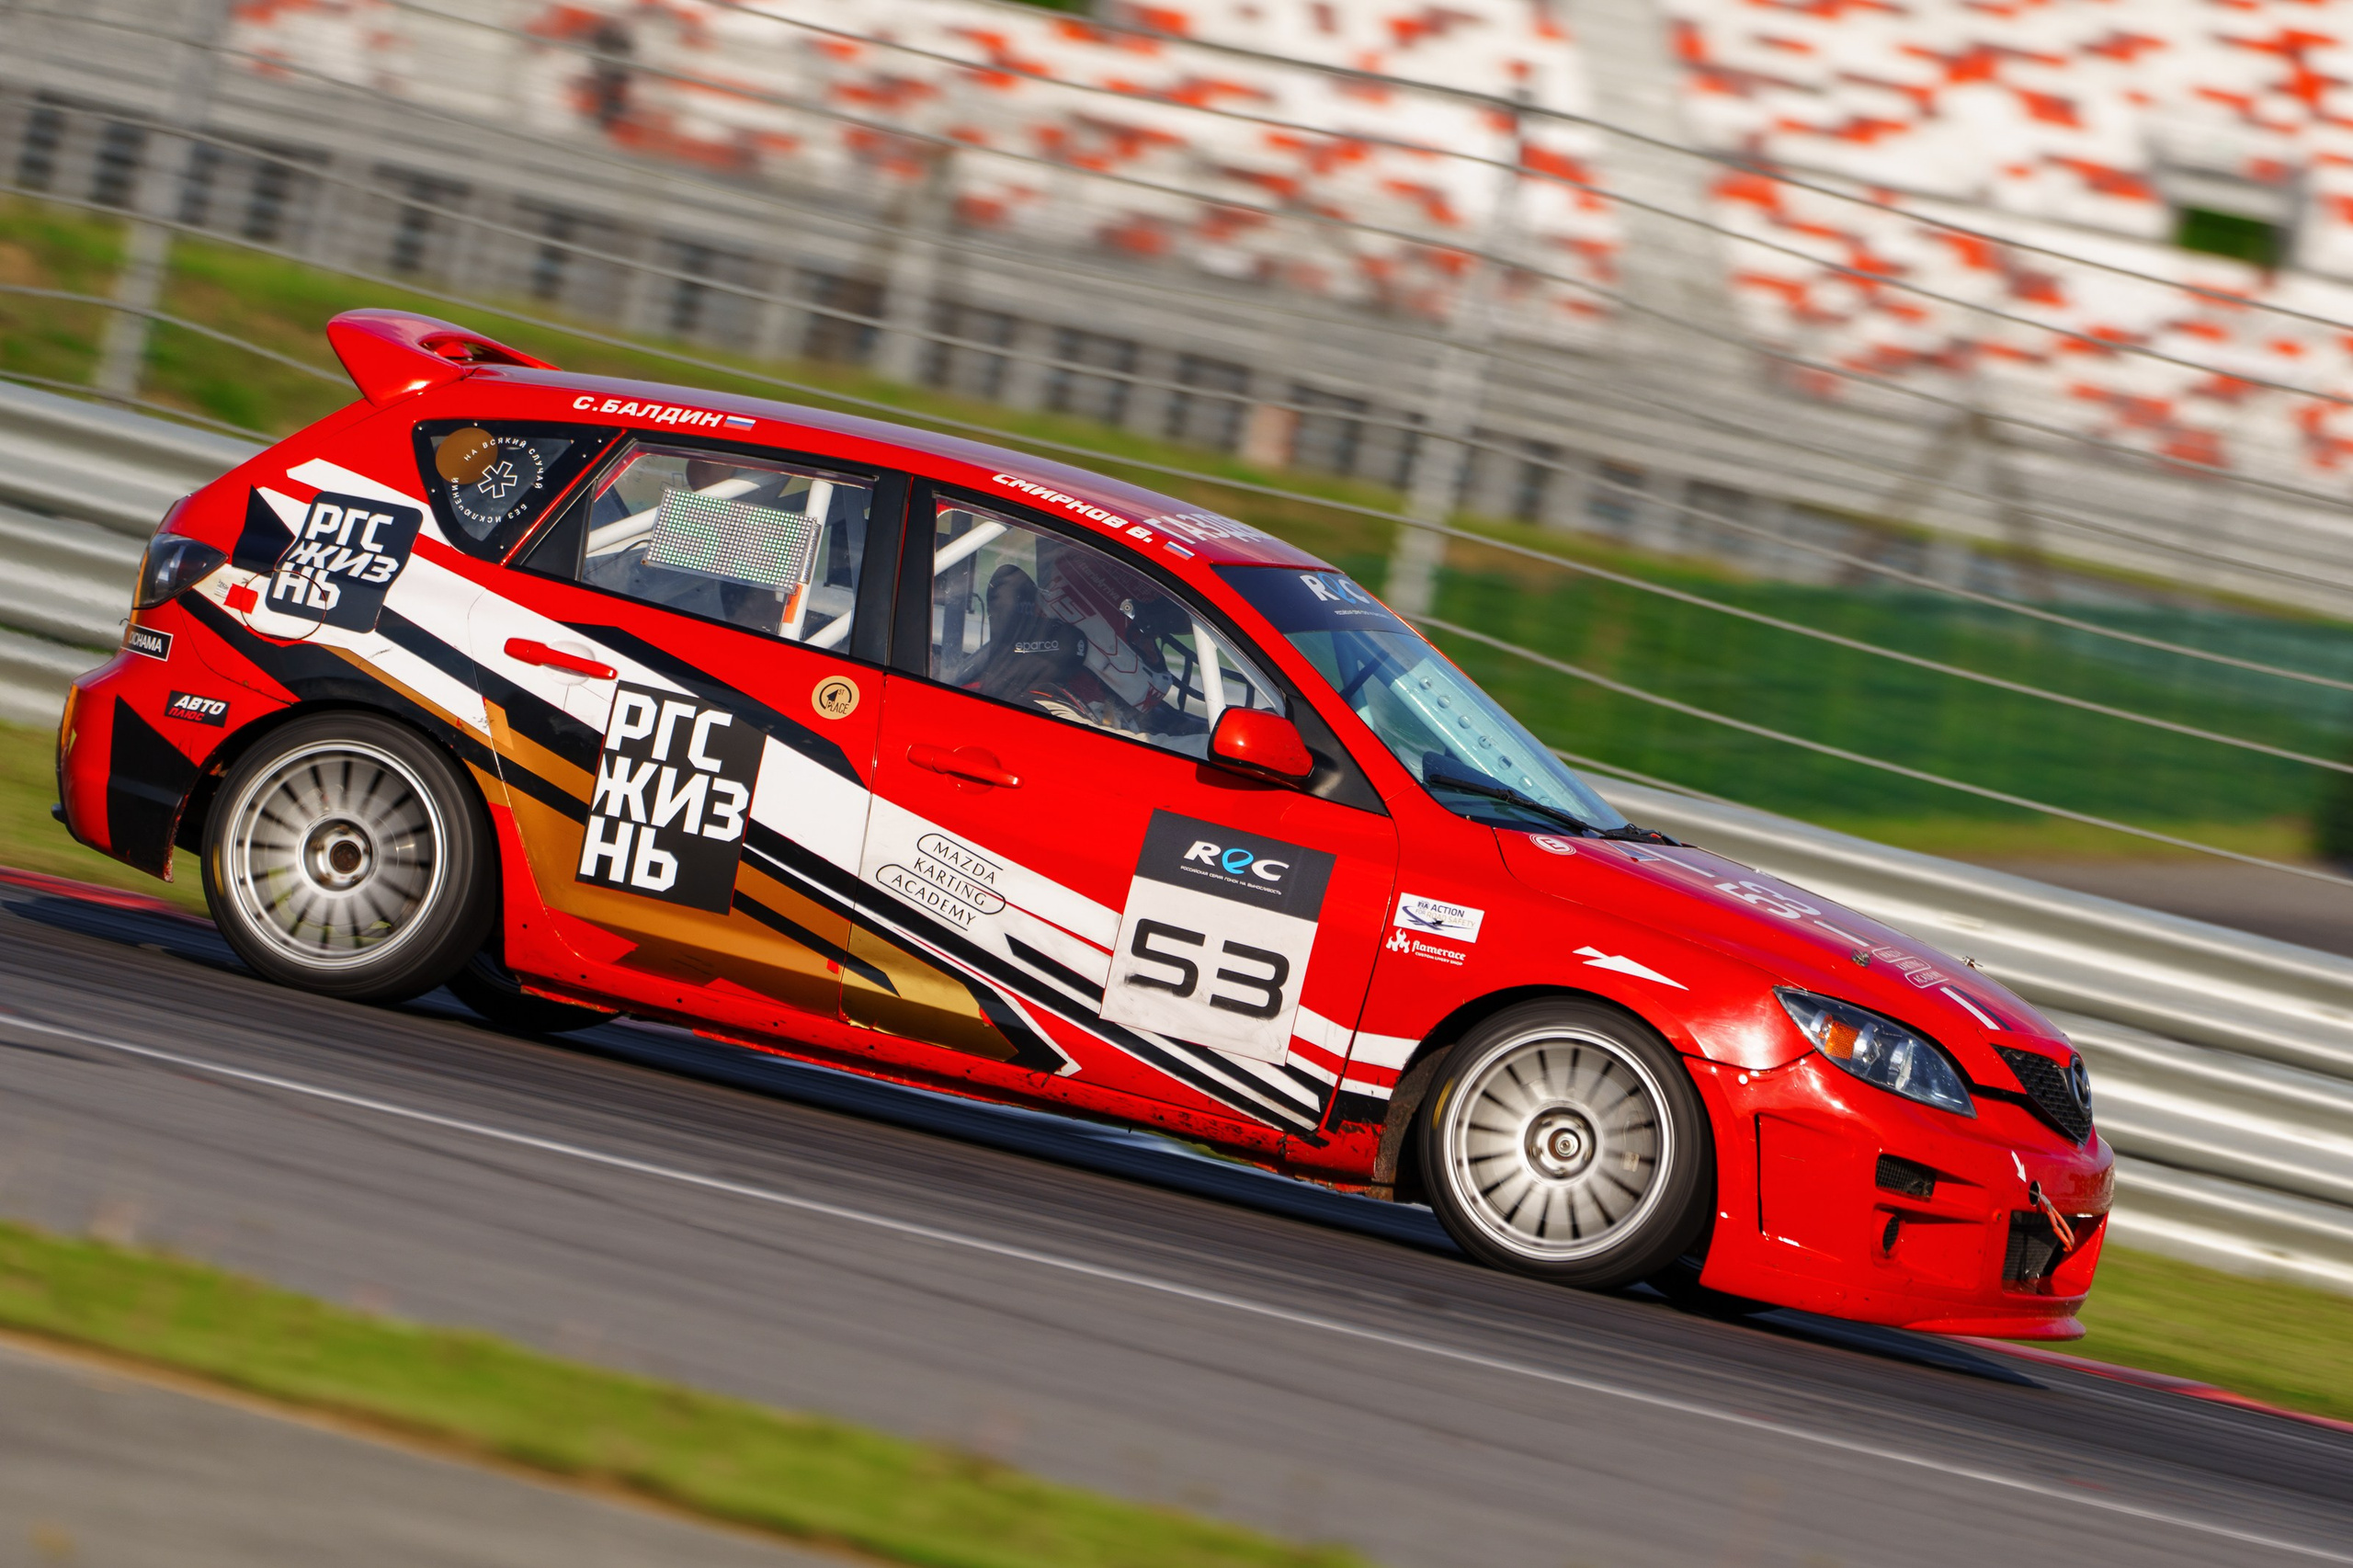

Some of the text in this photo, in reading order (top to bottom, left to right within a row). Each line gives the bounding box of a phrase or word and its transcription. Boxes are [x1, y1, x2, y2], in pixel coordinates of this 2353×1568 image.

[572, 395, 724, 428] С.БАЛДИН
[463, 437, 544, 489] НА ВСЯКИЙ СЛУЧАЙ
[304, 502, 394, 553] РГС
[507, 504, 528, 519] БЕЗ
[992, 473, 1153, 543] СМИРНОВ В.
[287, 540, 399, 584] ЖИЗ
[272, 562, 341, 611] НЬ
[167, 707, 205, 722] ПЛЮС
[174, 695, 226, 715] АВТО
[827, 700, 849, 714] PLACE
[605, 689, 733, 773] РГС
[592, 753, 750, 842] ЖИЗ
[579, 815, 678, 892] НЬ
[933, 842, 995, 884] MAZDA
[892, 874, 976, 926] ACADEMY
[914, 858, 987, 906] KARTING
[1714, 881, 1822, 919] 53
[1427, 910, 1447, 920] ROAD
[1449, 915, 1475, 927] SAFETY
[1430, 904, 1465, 917] ACTION
[1124, 917, 1290, 1021] 53
[1412, 940, 1467, 960] flamerace
